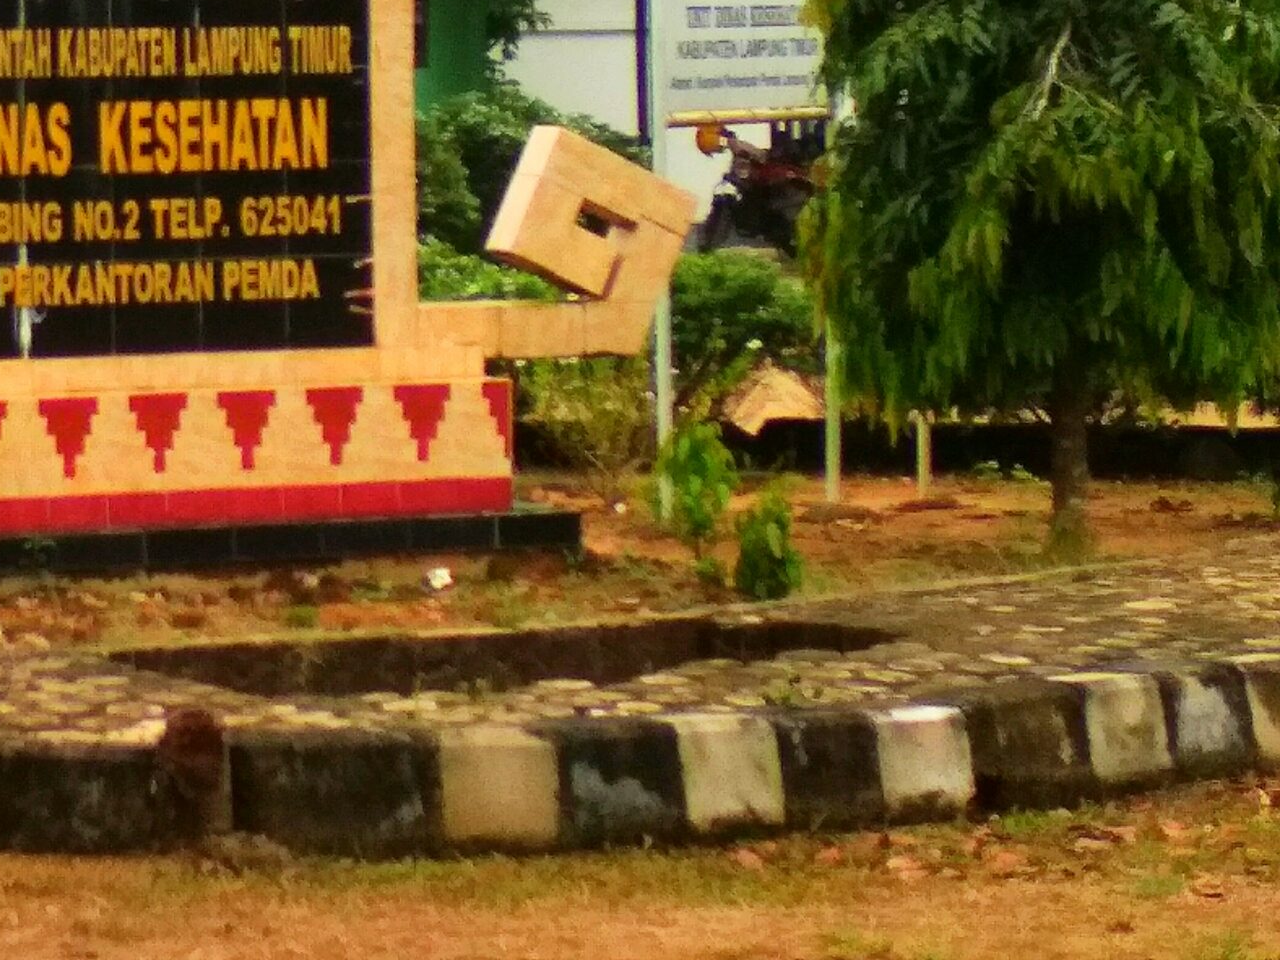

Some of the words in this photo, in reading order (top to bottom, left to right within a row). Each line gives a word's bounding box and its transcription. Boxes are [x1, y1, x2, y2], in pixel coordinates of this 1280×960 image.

[58, 29, 176, 78] KABUPATEN
[182, 27, 281, 76] LAMPUNG
[288, 26, 354, 74] TIMUR
[98, 97, 329, 175] KESEHATAN
[73, 201, 140, 241] NO.2
[151, 199, 230, 239] TELP.
[240, 194, 343, 236] 625041
[222, 258, 319, 301] PEMDA
